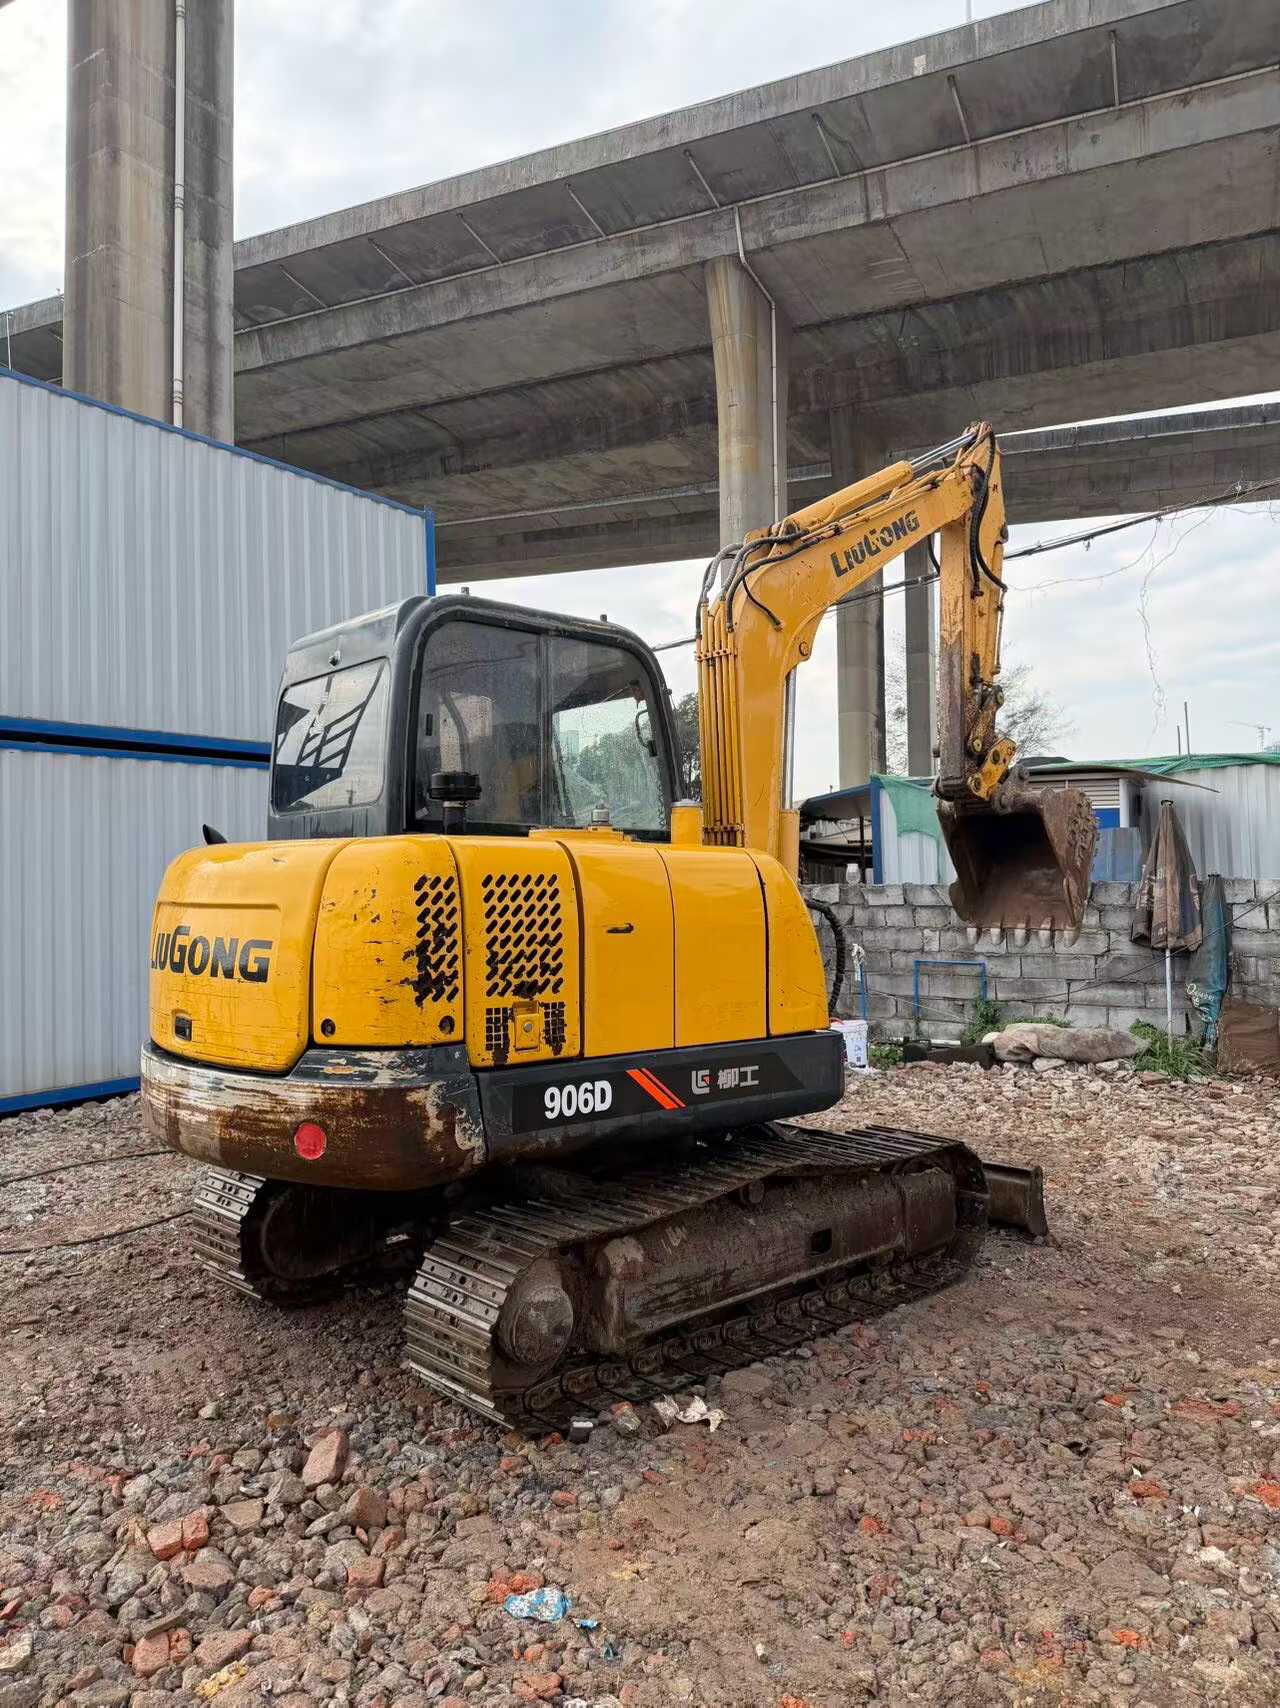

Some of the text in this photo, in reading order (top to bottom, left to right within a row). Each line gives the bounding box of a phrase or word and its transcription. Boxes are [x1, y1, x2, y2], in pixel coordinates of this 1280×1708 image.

[830, 510, 920, 577] LIUGONG
[717, 1065, 760, 1089] 柳工
[543, 1080, 613, 1120] 906D
